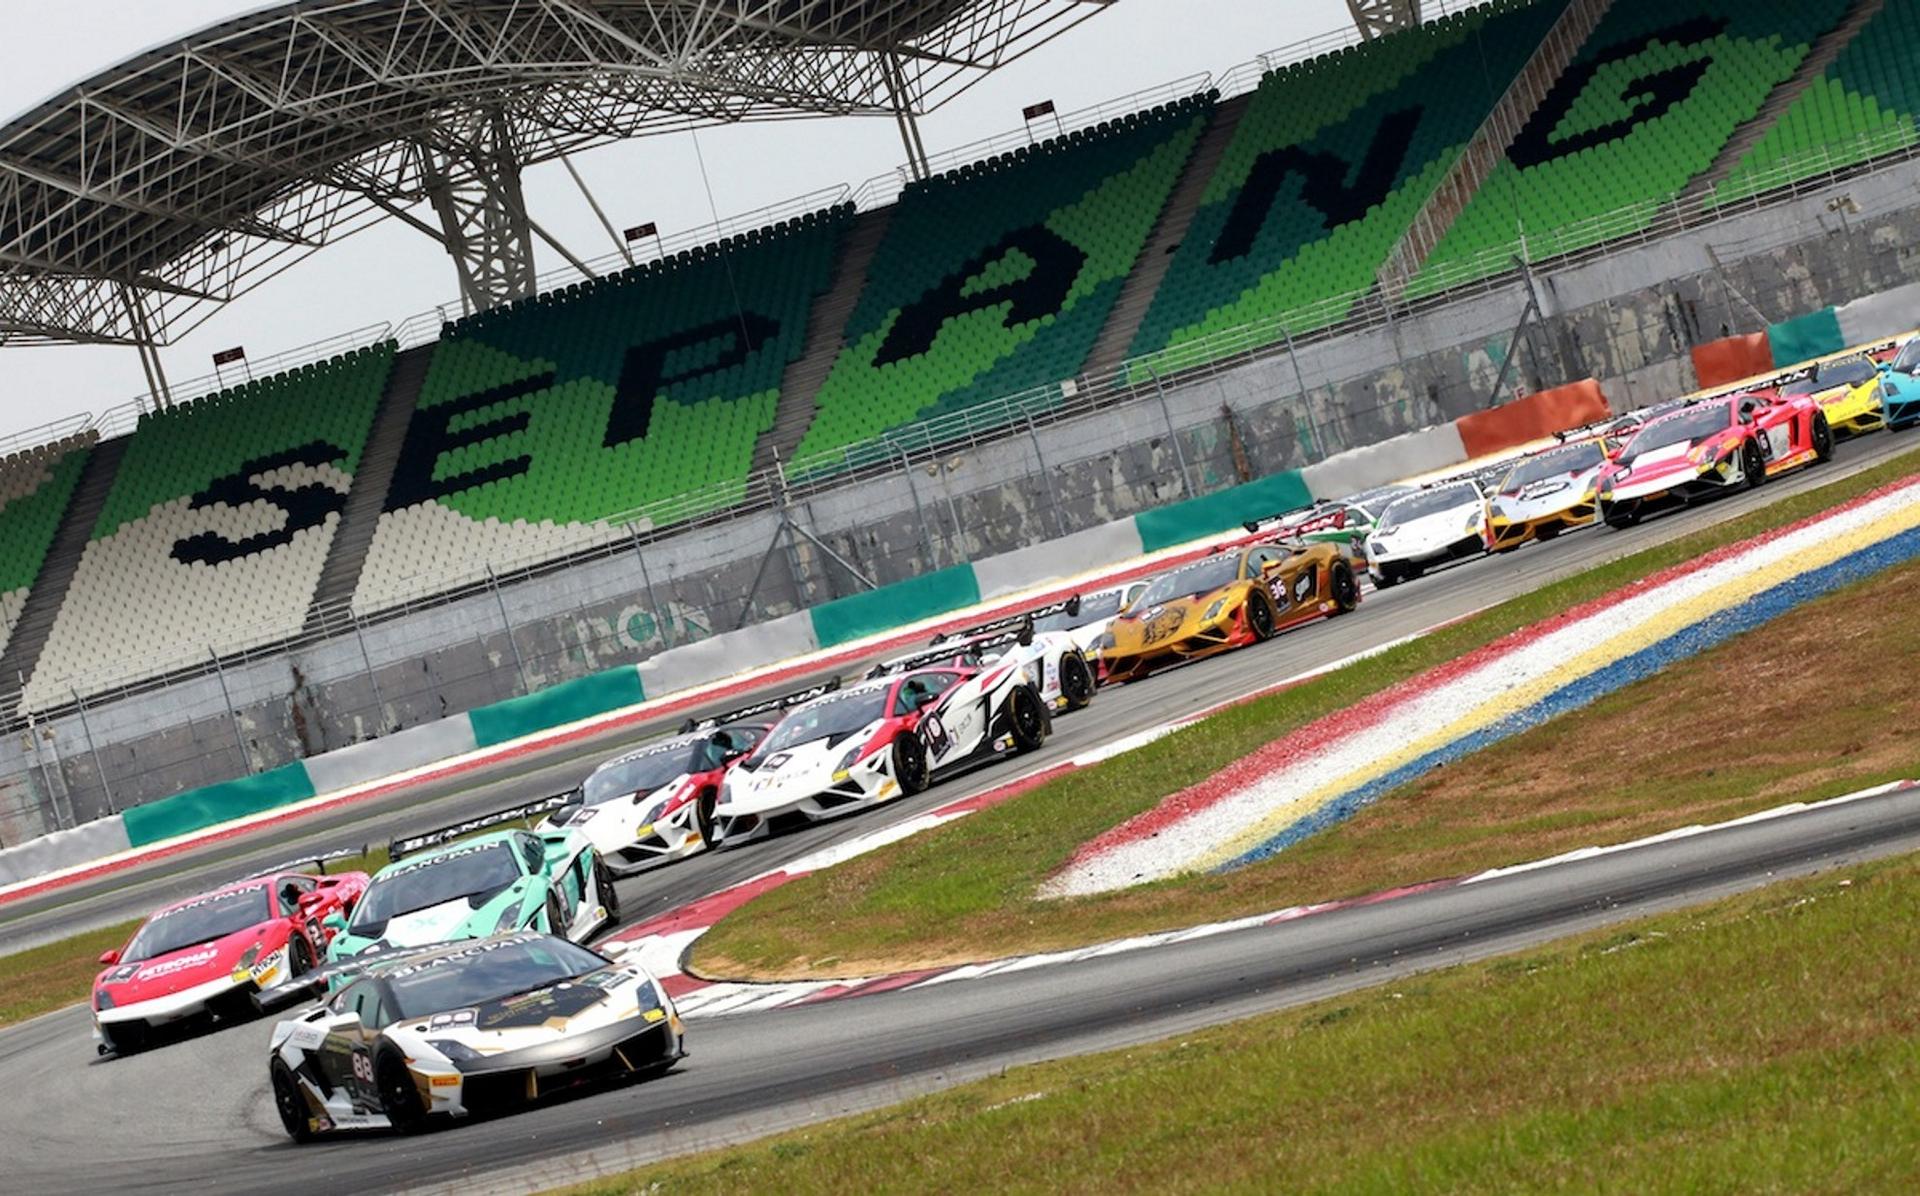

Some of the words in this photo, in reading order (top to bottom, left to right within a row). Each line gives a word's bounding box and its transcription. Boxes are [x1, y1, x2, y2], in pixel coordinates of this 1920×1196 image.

[170, 15, 1730, 567] SEPANG
[403, 794, 571, 853] BLANCPAIN
[377, 840, 501, 884] BLANCPAIN
[149, 883, 263, 923] BLANCPAIN
[352, 1051, 375, 1083] 88
